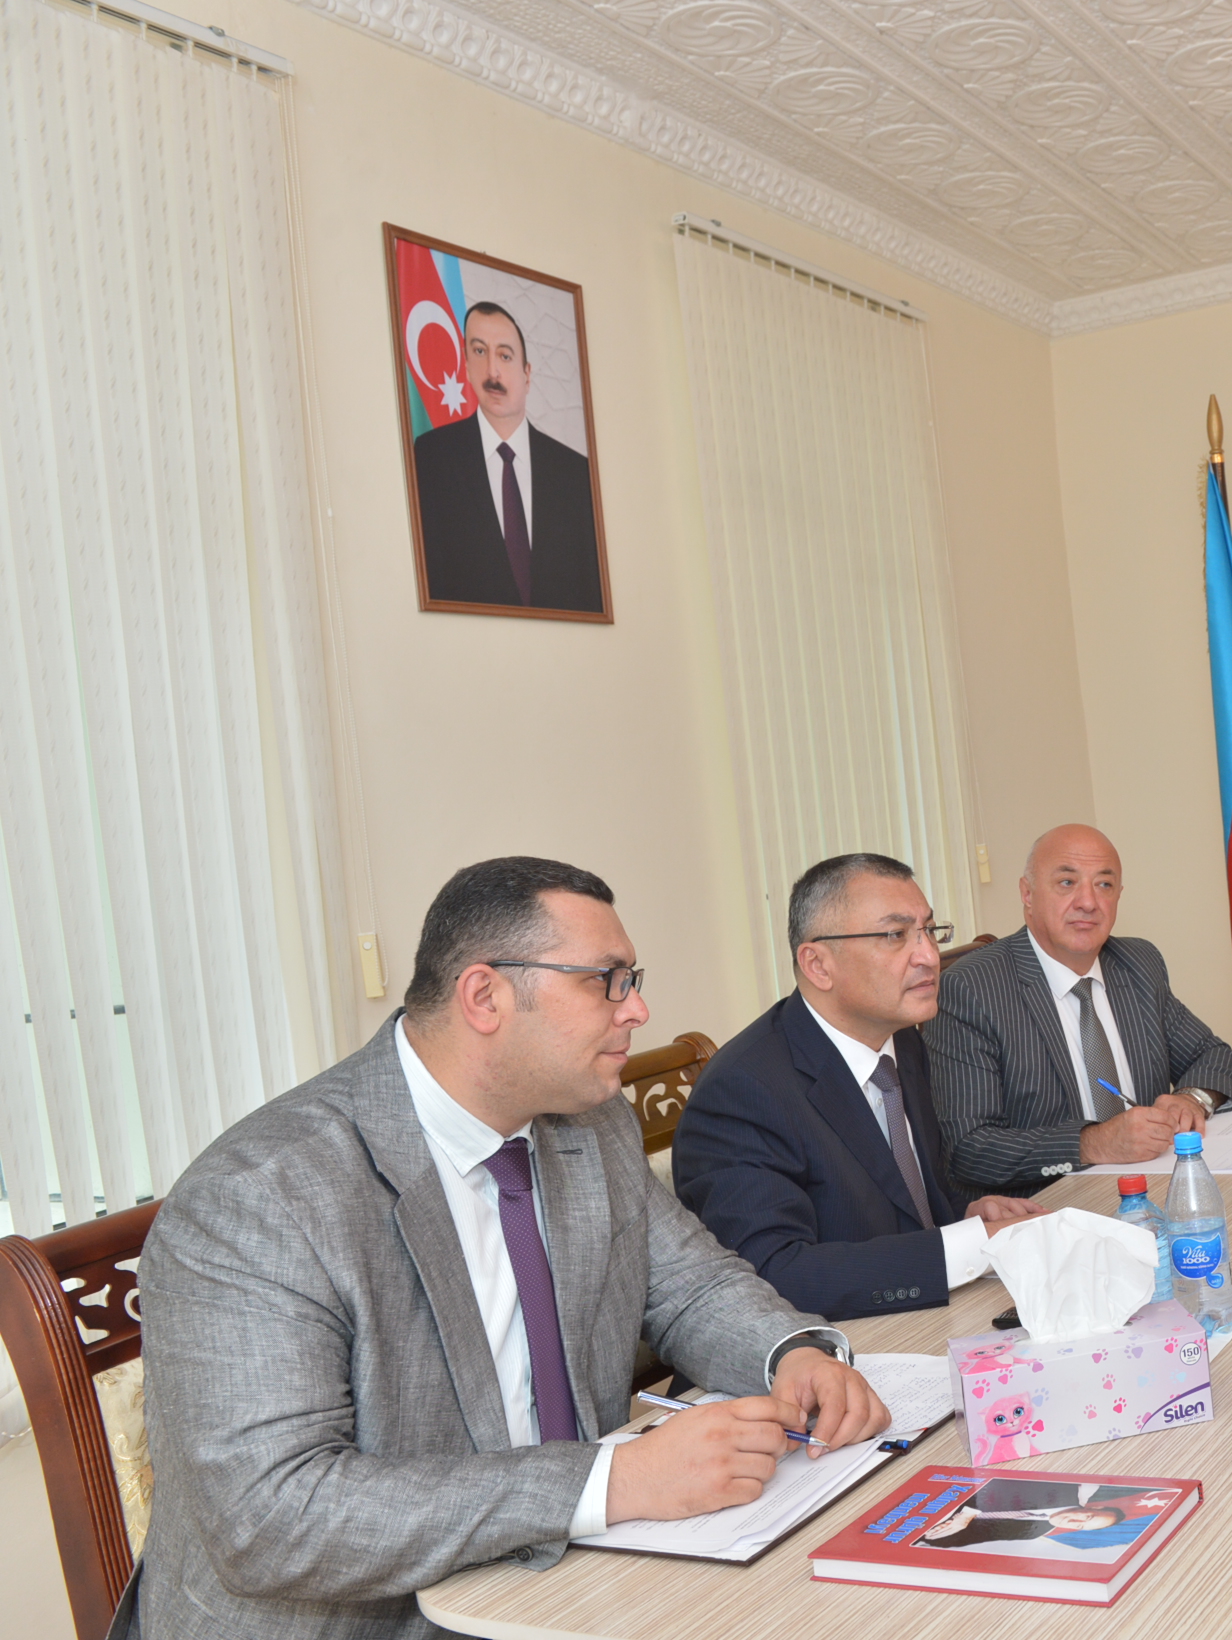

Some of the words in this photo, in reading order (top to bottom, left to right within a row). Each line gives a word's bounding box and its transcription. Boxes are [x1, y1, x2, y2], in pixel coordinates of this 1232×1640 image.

[1182, 1245, 1206, 1258] Vita
[1182, 1256, 1210, 1264] 1000
[1181, 1346, 1200, 1358] 150
[1163, 1400, 1205, 1424] Silen
